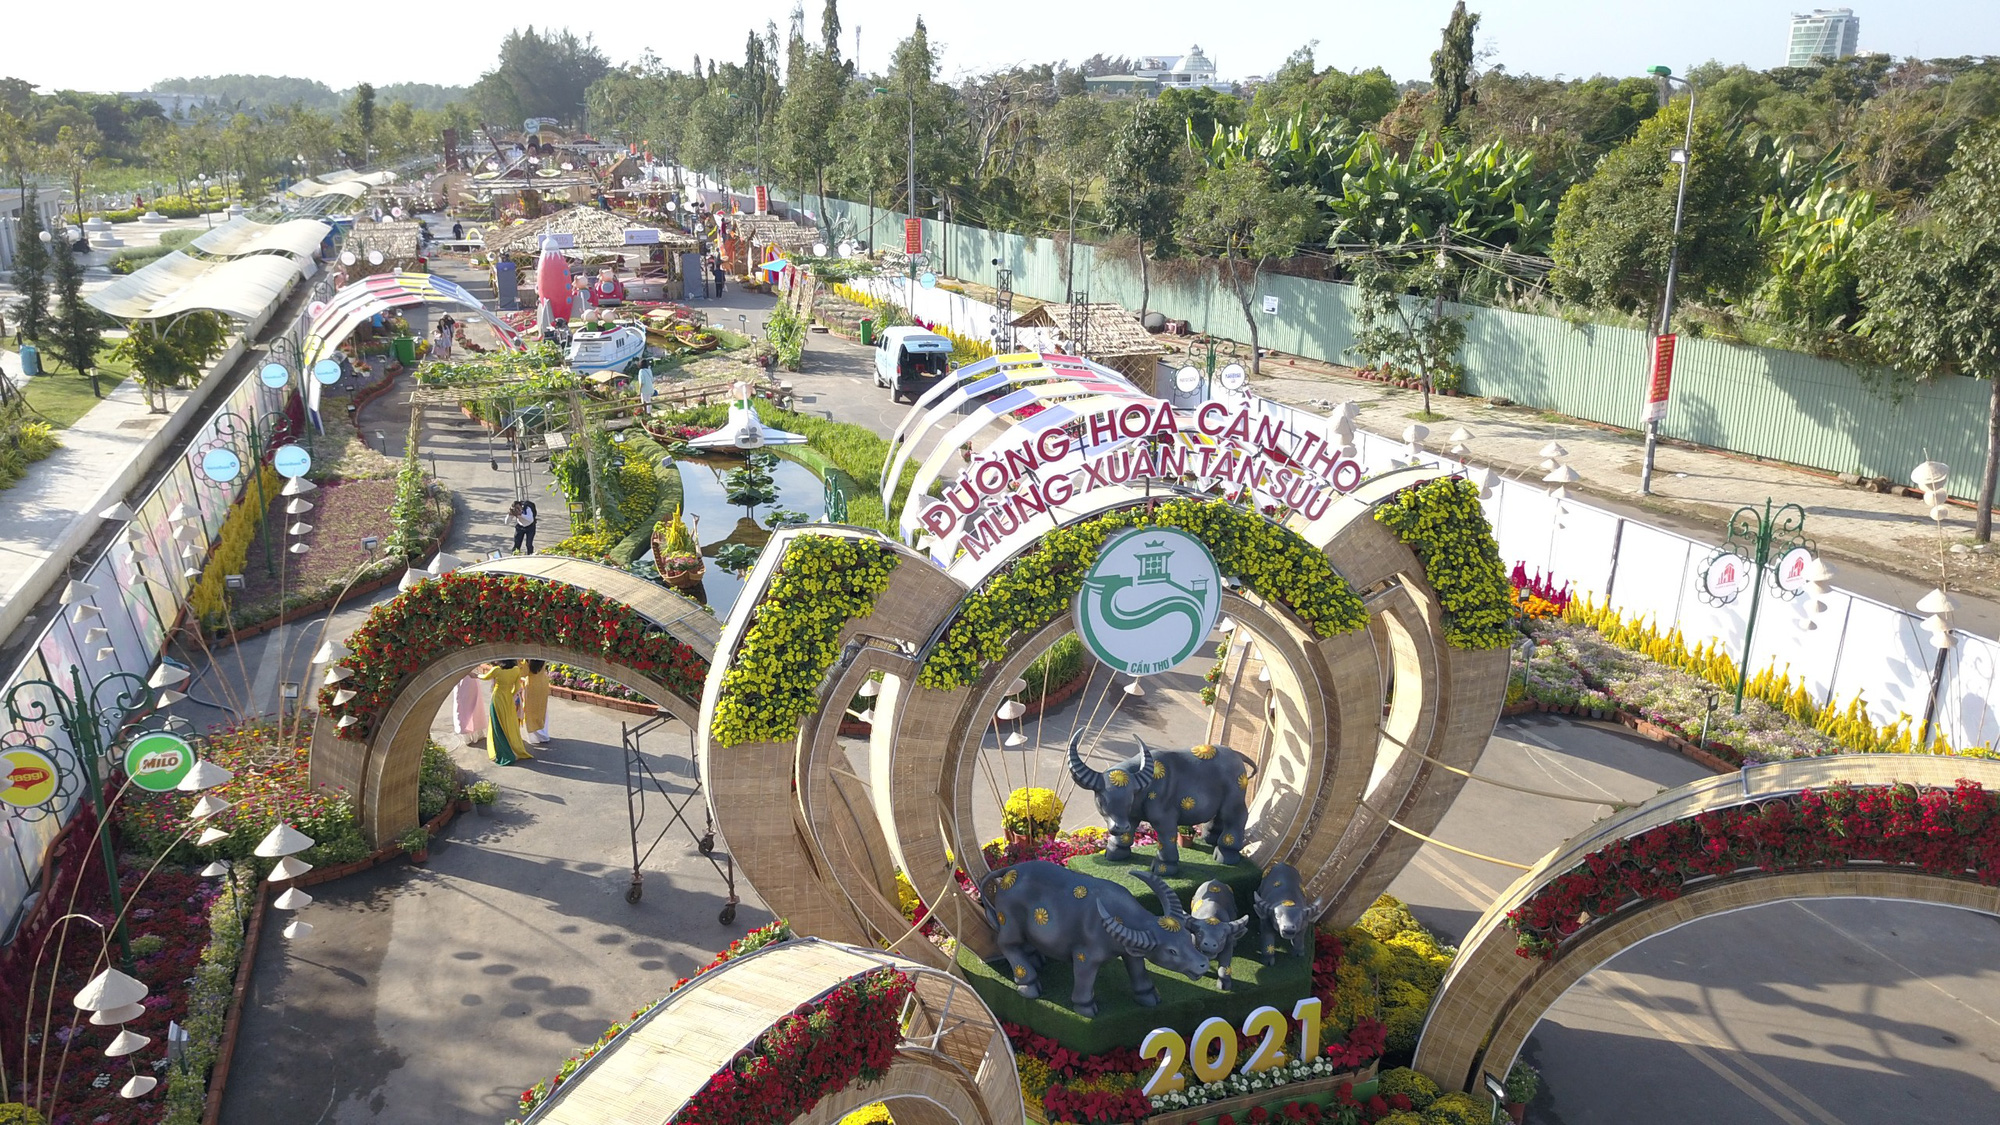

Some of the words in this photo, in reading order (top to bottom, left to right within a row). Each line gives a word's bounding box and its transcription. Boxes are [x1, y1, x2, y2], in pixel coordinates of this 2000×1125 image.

[921, 428, 1071, 539] ĐƯỜNG
[1089, 402, 1178, 447] HOA
[1198, 390, 1284, 450] CẦN
[1297, 430, 1369, 492] THƠ
[960, 474, 1073, 561] MỪNG
[1081, 440, 1186, 493] XUÂN
[1199, 443, 1266, 489] TÂN
[1270, 468, 1332, 521] SỬU
[1153, 657, 1169, 672] THƠ
[143, 757, 179, 769] MILO
[1139, 996, 1322, 1097] 2021
